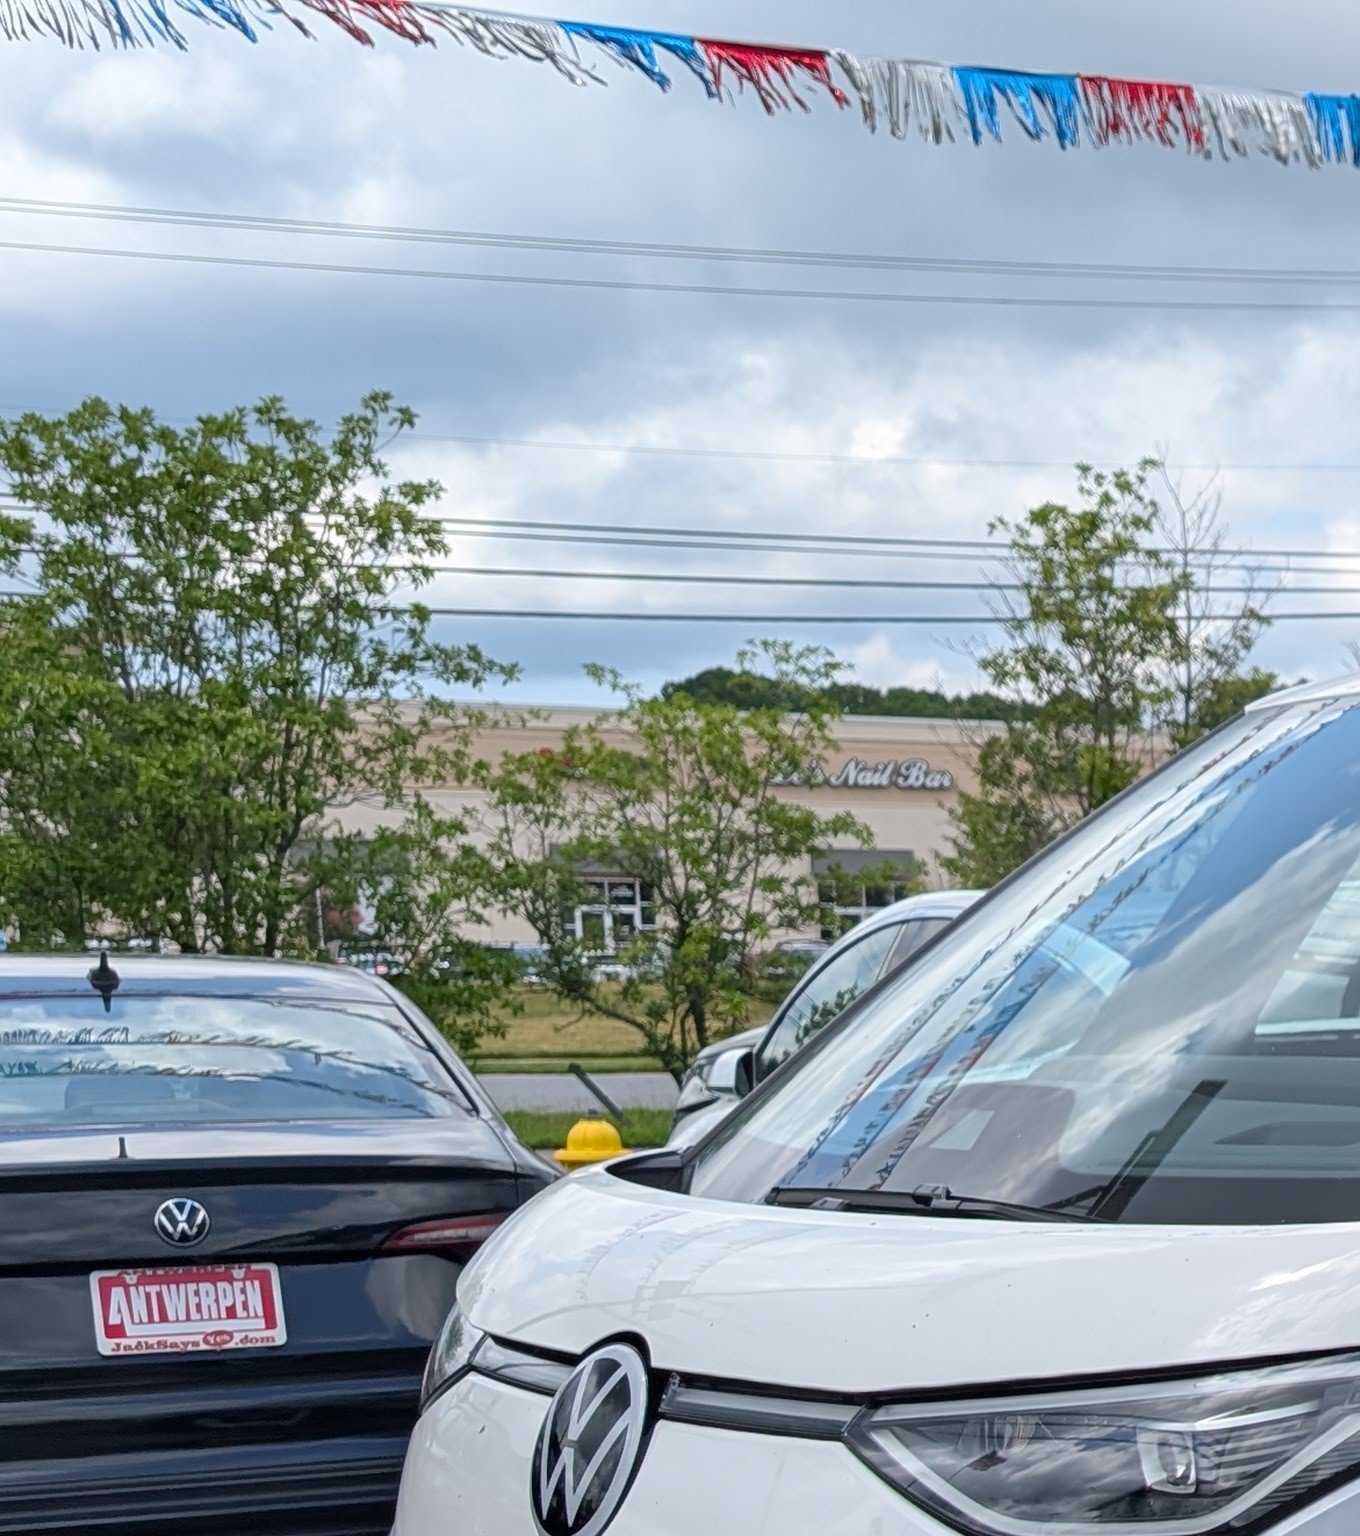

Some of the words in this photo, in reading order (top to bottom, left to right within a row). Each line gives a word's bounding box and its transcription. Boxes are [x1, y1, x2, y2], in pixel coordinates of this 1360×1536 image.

[828, 757, 896, 787] Nail
[897, 758, 952, 789] Bar
[108, 1280, 265, 1335] ANTWERPEN
